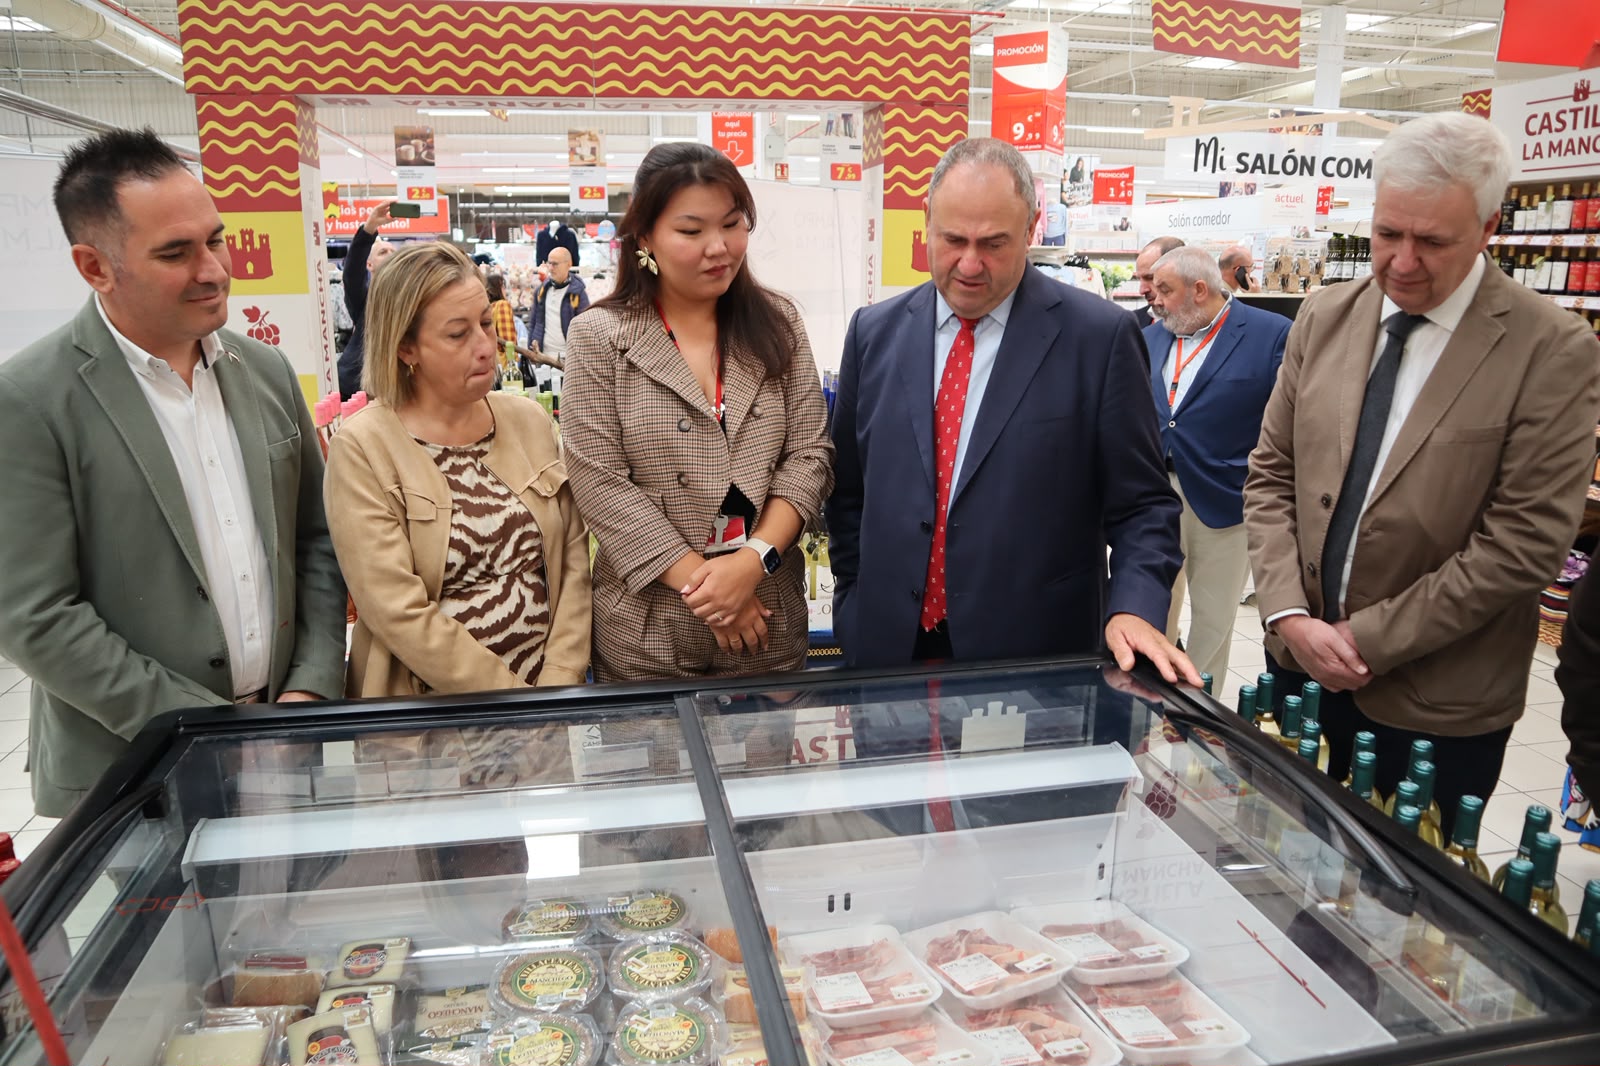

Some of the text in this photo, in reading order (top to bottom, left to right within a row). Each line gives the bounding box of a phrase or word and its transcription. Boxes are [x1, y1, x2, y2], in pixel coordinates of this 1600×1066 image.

[997, 43, 1044, 56] PROMOCIÓN
[725, 120, 740, 128] aquí
[1524, 103, 1600, 136] CASTIL
[727, 130, 747, 139] precio
[1193, 136, 1373, 179] Mi SALÓN COM
[1522, 142, 1544, 161] LA
[1168, 211, 1232, 228] Salón comedor
[326, 222, 333, 233] y
[427, 1005, 484, 1019] MANCHEGO
